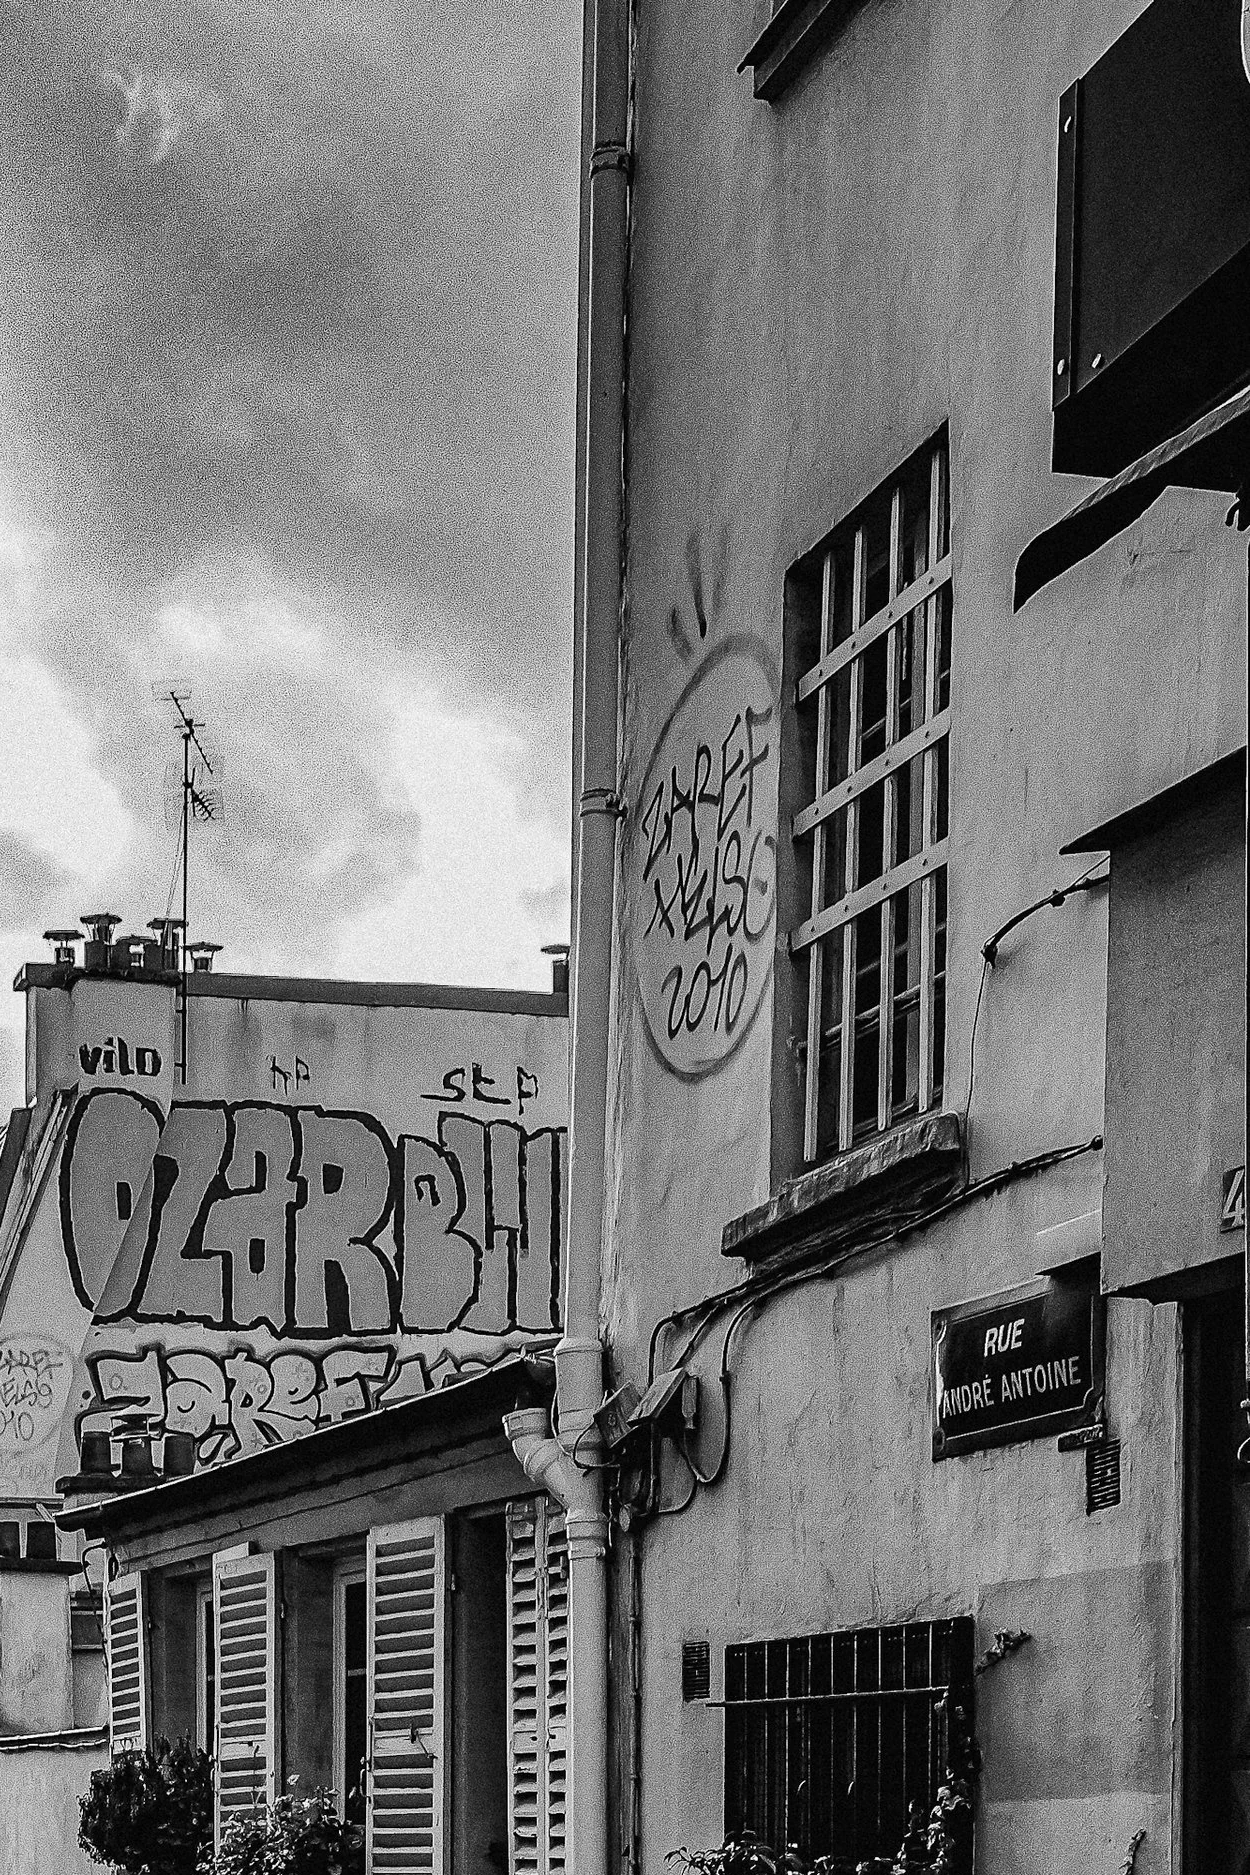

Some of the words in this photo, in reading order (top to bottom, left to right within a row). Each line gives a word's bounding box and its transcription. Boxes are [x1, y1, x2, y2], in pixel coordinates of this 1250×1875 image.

[661, 942, 748, 1040] 2010
[984, 1318, 1025, 1358] RUE
[942, 1373, 995, 1419] ANDRÉ
[1001, 1355, 1082, 1403] ANTOINE
